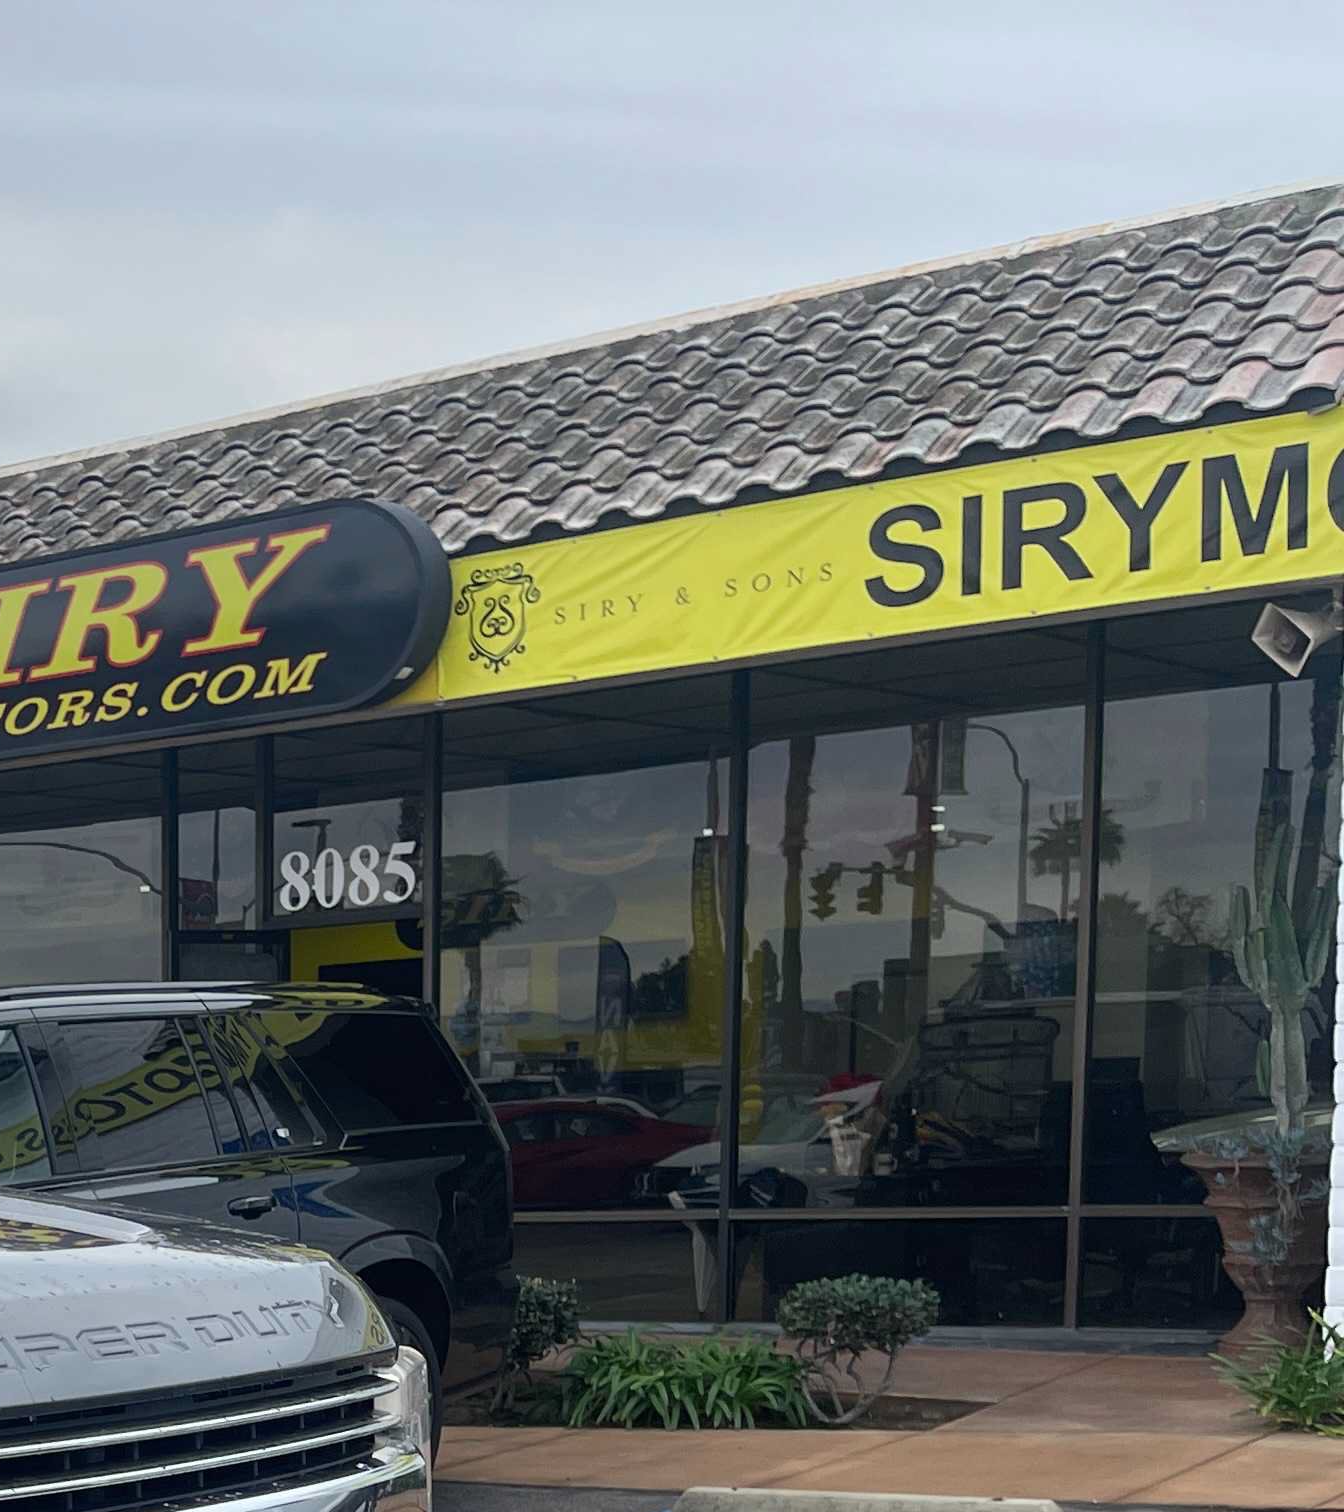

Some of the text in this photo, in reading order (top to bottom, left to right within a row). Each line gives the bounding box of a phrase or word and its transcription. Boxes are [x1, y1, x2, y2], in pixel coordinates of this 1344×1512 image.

[865, 442, 1344, 607] SIRYM
[554, 562, 834, 626] SIRY & SONS
[280, 841, 416, 912] 8085
